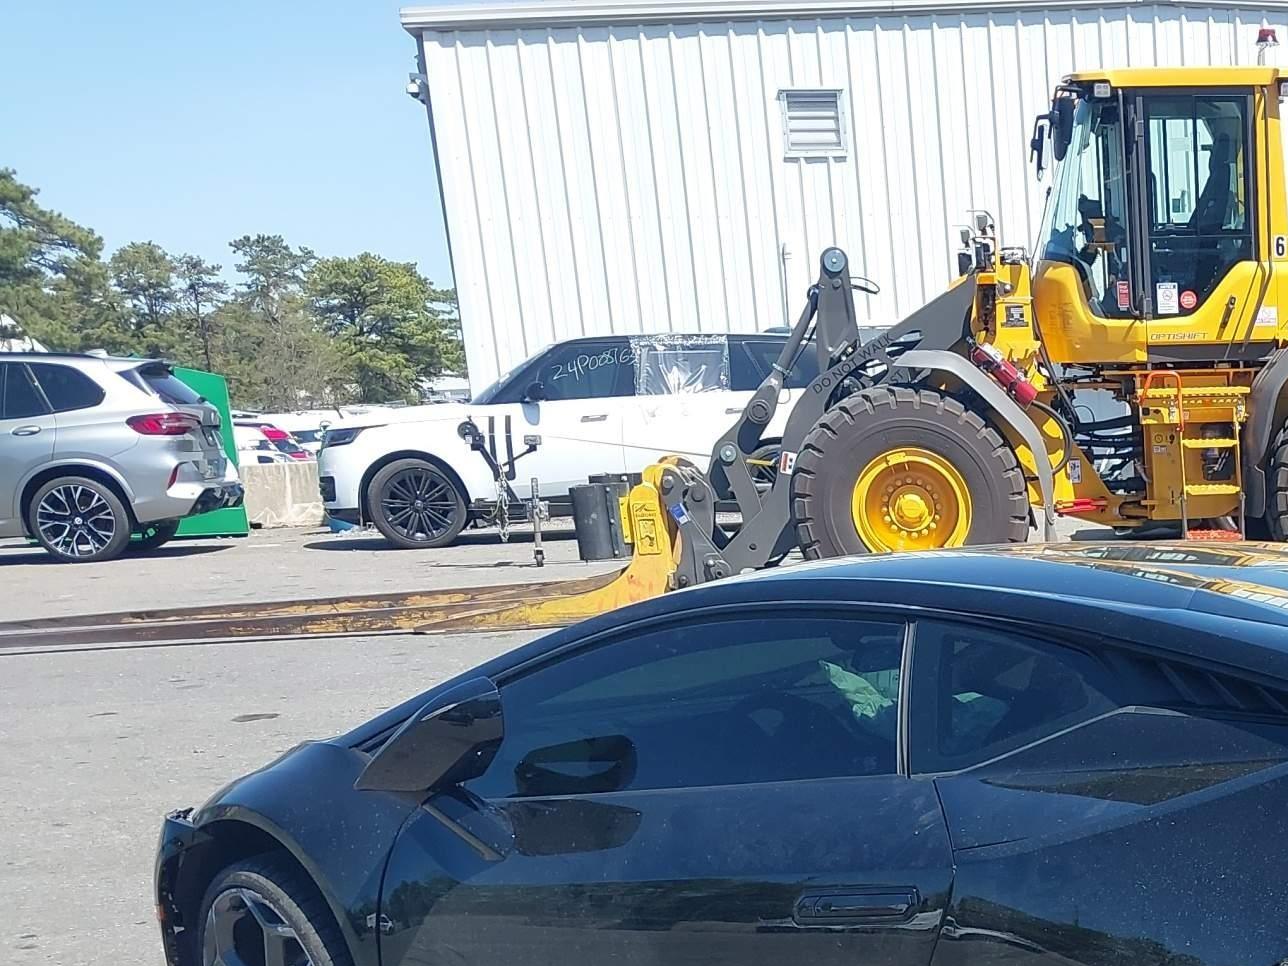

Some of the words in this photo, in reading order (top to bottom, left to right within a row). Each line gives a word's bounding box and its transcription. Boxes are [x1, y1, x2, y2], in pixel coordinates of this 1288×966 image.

[1275, 236, 1285, 256] 6
[1150, 332, 1209, 341] OPTISHIFT
[813, 377, 831, 394] DO
[831, 359, 857, 379] NOT
[859, 333, 894, 360] WALK
